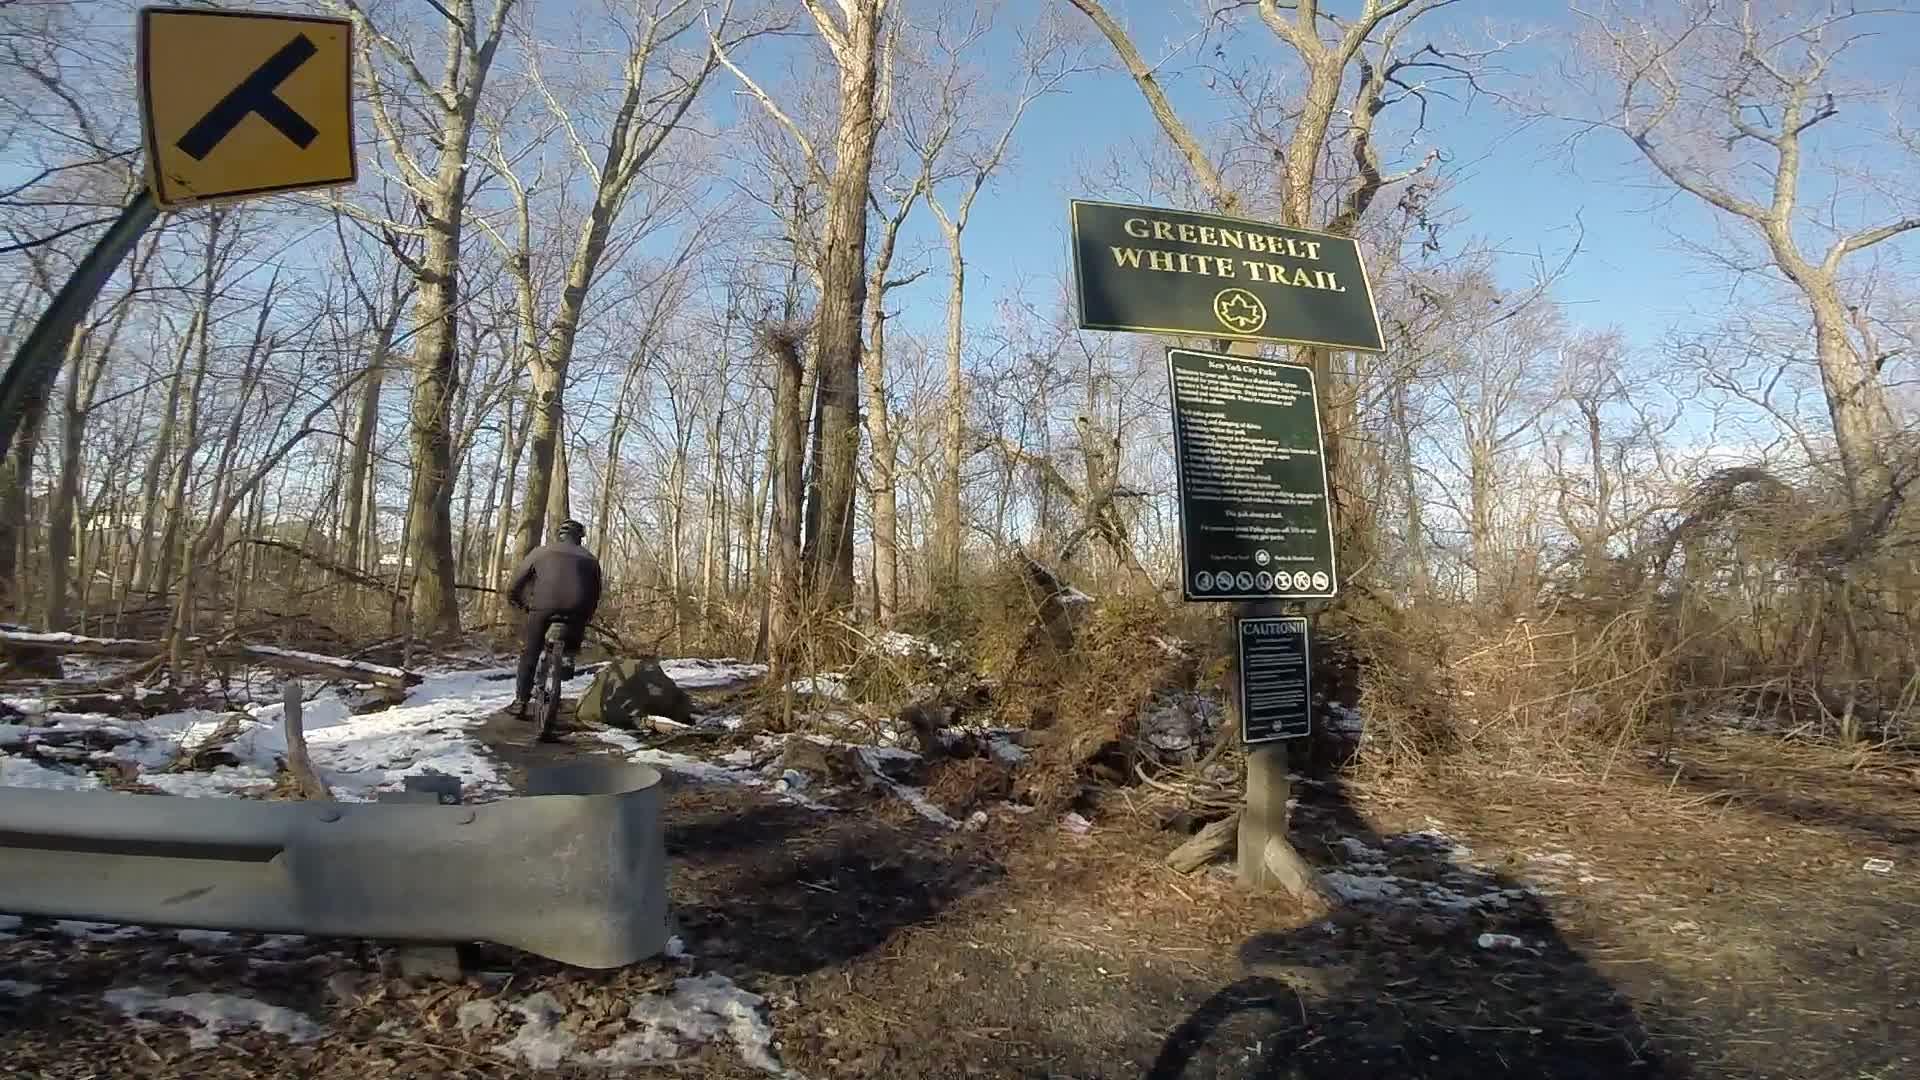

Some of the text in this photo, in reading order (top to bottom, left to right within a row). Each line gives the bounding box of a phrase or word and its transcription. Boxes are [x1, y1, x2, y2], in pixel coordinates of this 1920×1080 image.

[1124, 218, 1320, 260] GREENBELT
[1109, 246, 1346, 292] WHITE TRAIL
